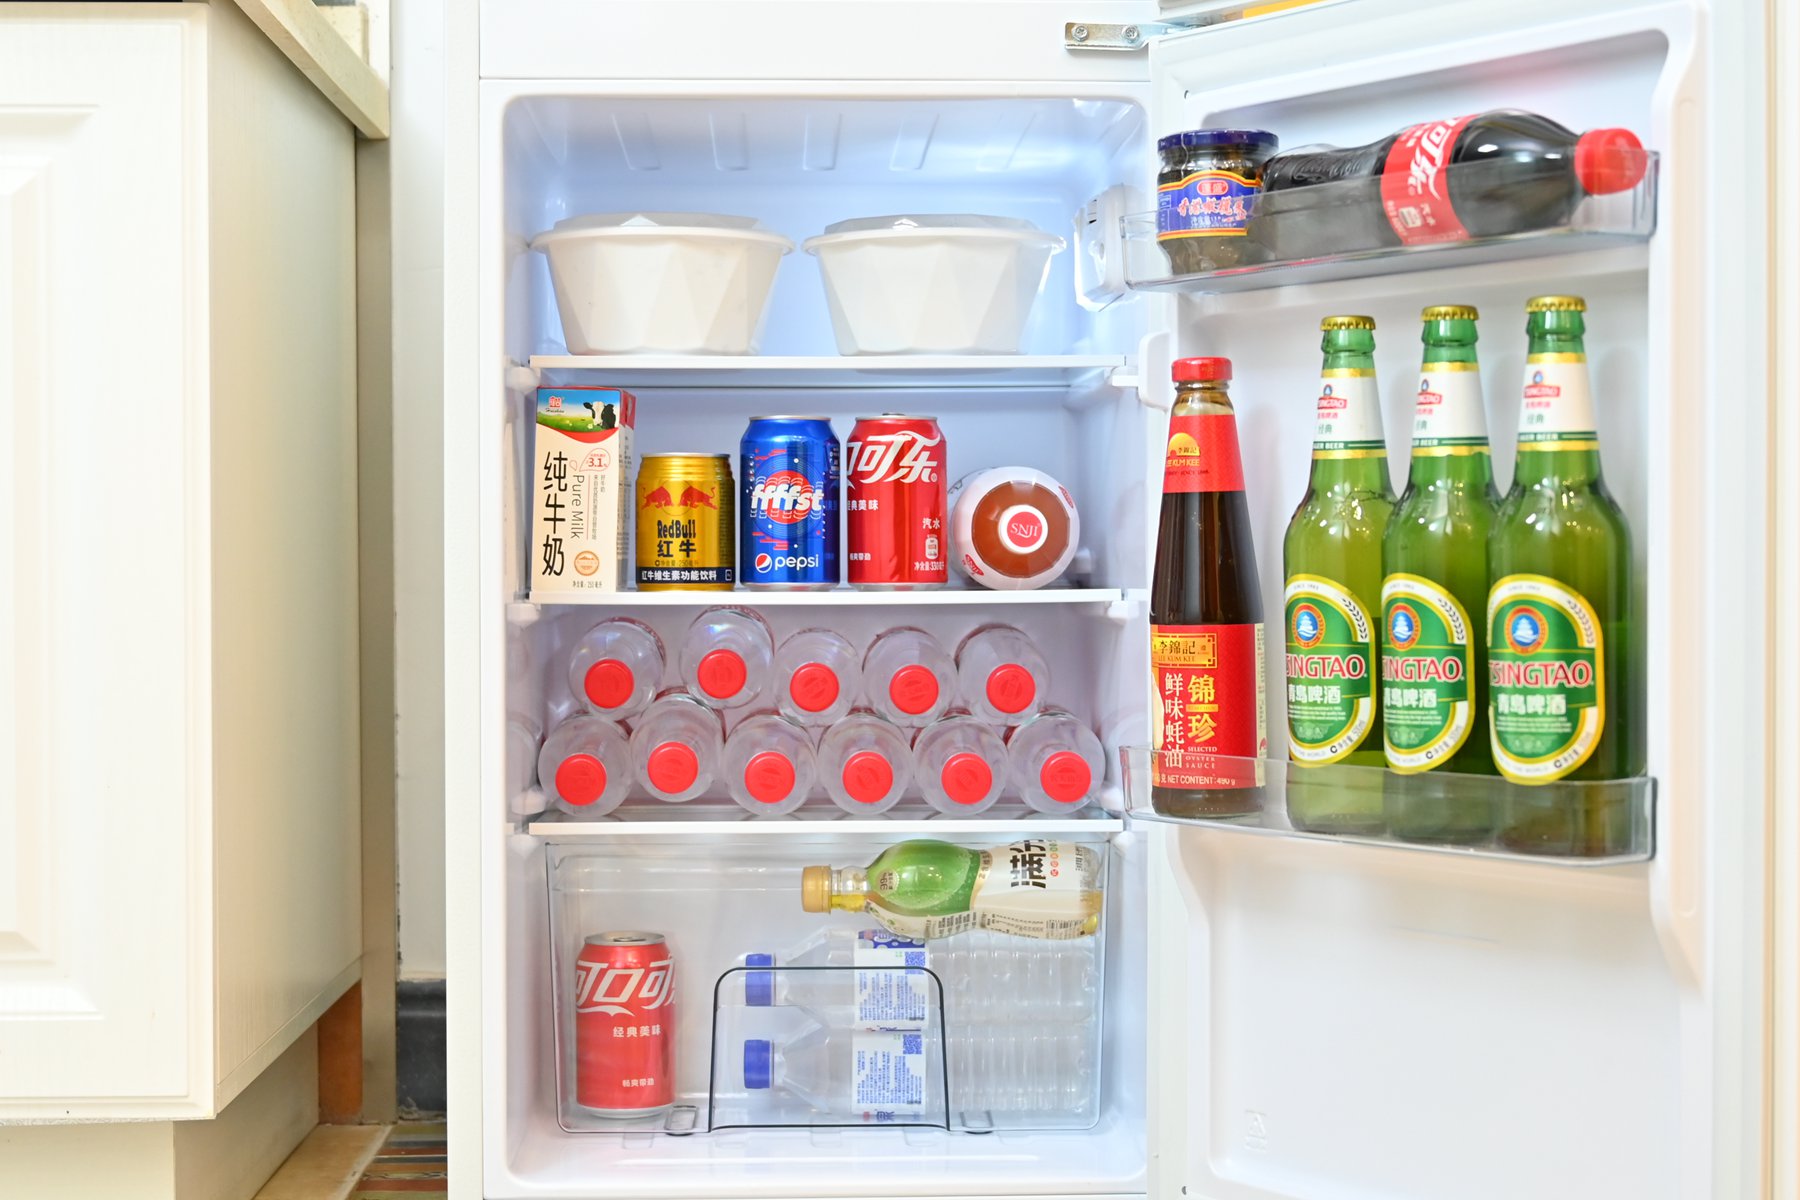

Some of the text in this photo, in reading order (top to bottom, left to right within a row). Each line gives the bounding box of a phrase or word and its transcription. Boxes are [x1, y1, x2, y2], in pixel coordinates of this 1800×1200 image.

[542, 451, 568, 577] 纯牛奶
[570, 474, 585, 539] Pure Milk
[657, 519, 697, 539] RedBull
[922, 517, 941, 530] 汽水
[657, 539, 697, 558] 红牛
[774, 553, 819, 571] pepsi
[641, 569, 717, 581] 红牛维生素功能饮料
[1187, 674, 1218, 744] 锦珍
[1164, 672, 1186, 769] 鲜味蚝油
[1168, 774, 1180, 784] NET
[576, 958, 676, 1010] 可口可
[613, 1024, 662, 1038] 经典美味
